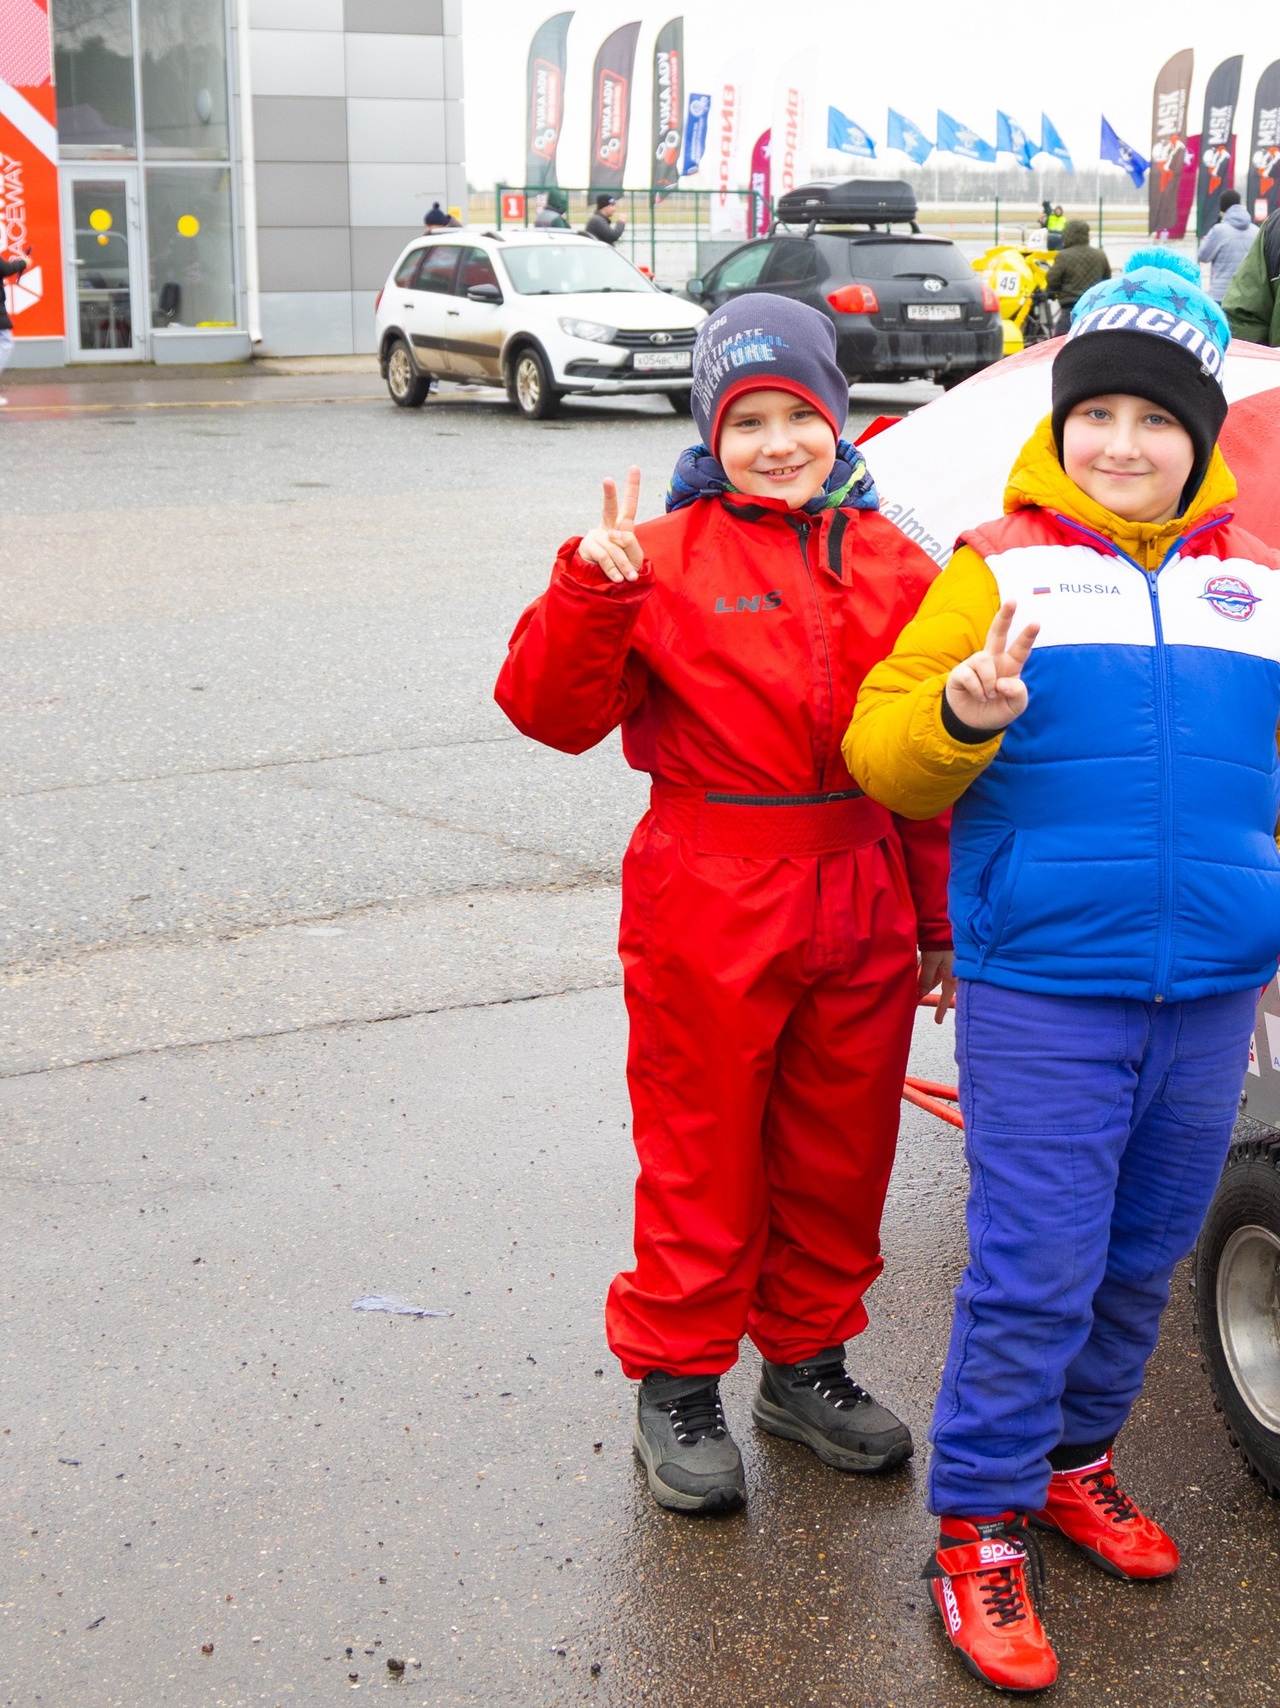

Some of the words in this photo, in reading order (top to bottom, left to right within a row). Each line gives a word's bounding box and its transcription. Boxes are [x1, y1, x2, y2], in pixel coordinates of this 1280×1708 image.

[537, 70, 547, 95] ADV
[657, 52, 671, 86] ADV
[603, 80, 614, 105] ADV
[536, 96, 547, 130] YUKA
[601, 106, 612, 138] YUKA
[659, 87, 671, 136] YUKA
[1157, 90, 1180, 137] MSK
[1207, 105, 1228, 145] MSK
[1257, 108, 1278, 146] MSK
[508, 198, 519, 216] 1
[1000, 277, 1017, 291] 45
[715, 590, 783, 613] LNS
[1059, 583, 1121, 595] RUSSIA
